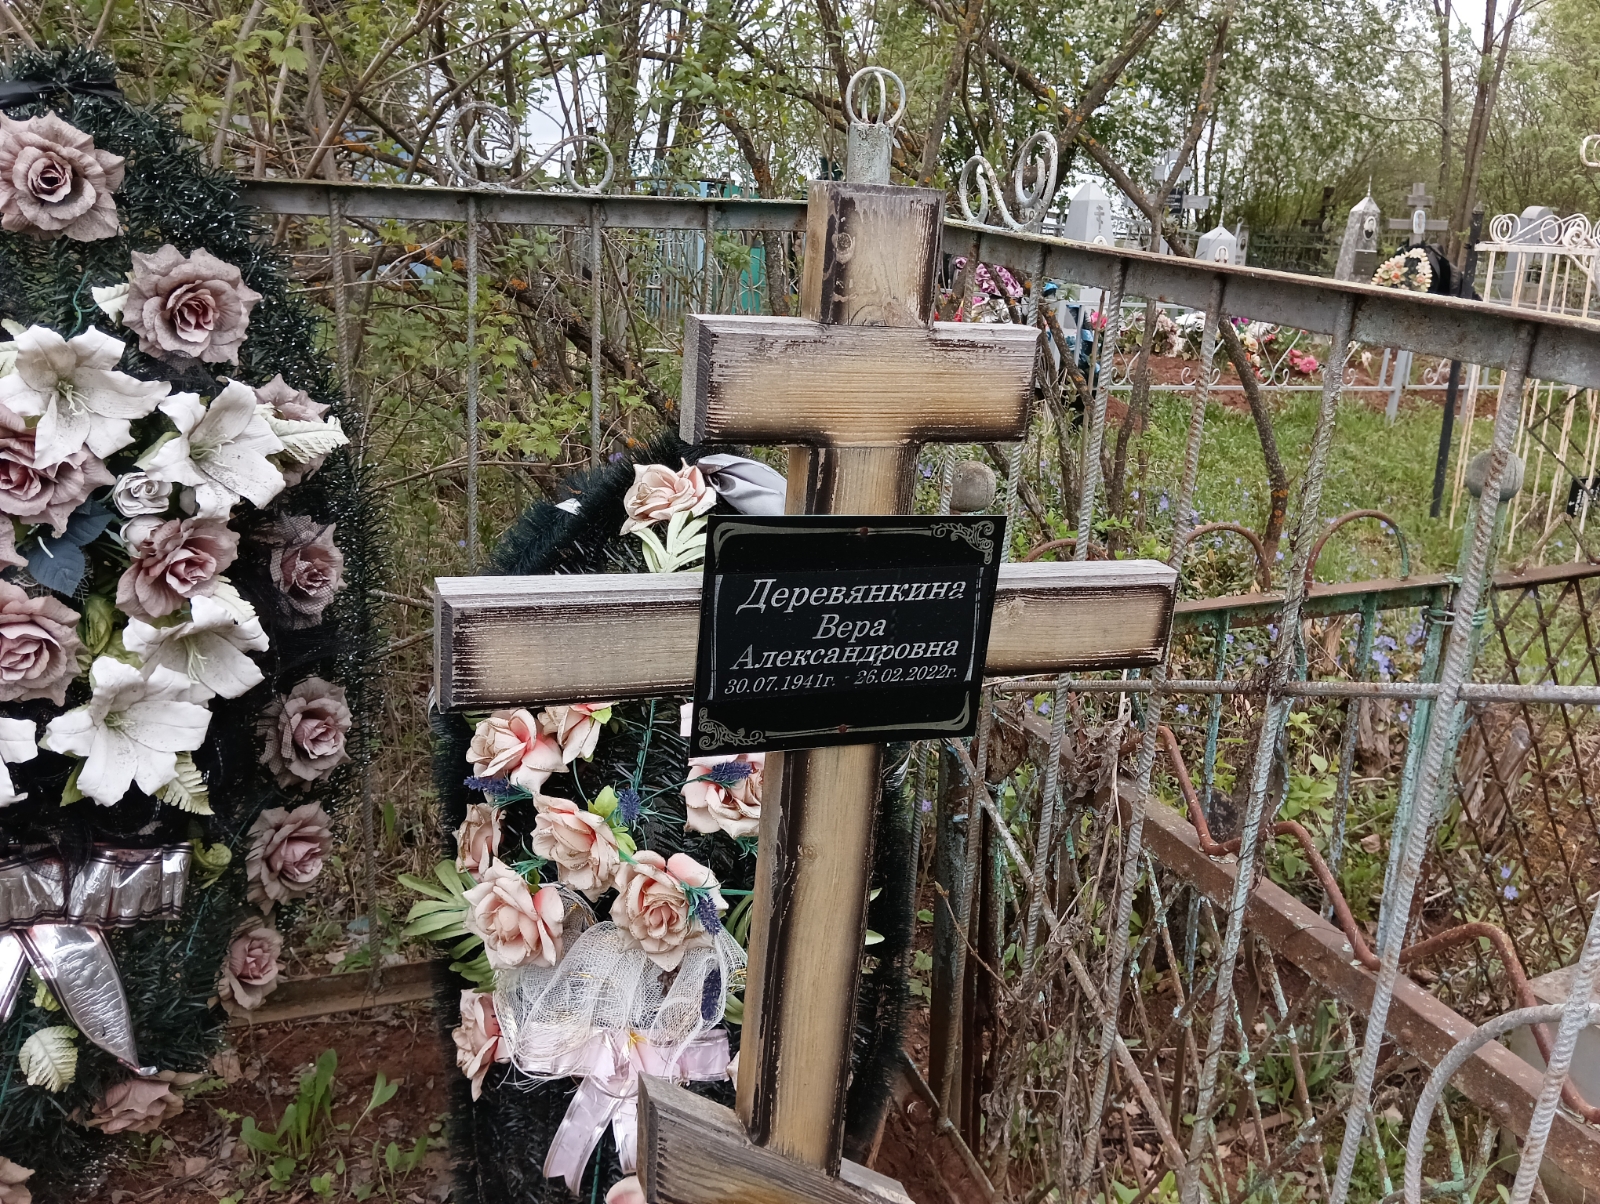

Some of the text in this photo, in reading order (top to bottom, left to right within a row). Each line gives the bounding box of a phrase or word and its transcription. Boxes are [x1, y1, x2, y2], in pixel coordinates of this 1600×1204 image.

[736, 579, 966, 614] Деревянкина
[813, 614, 887, 643] Вера
[730, 640, 959, 670] Александровна
[724, 674, 836, 695] 30.07.1941г.
[854, 665, 958, 685] 26.02.2022г.
